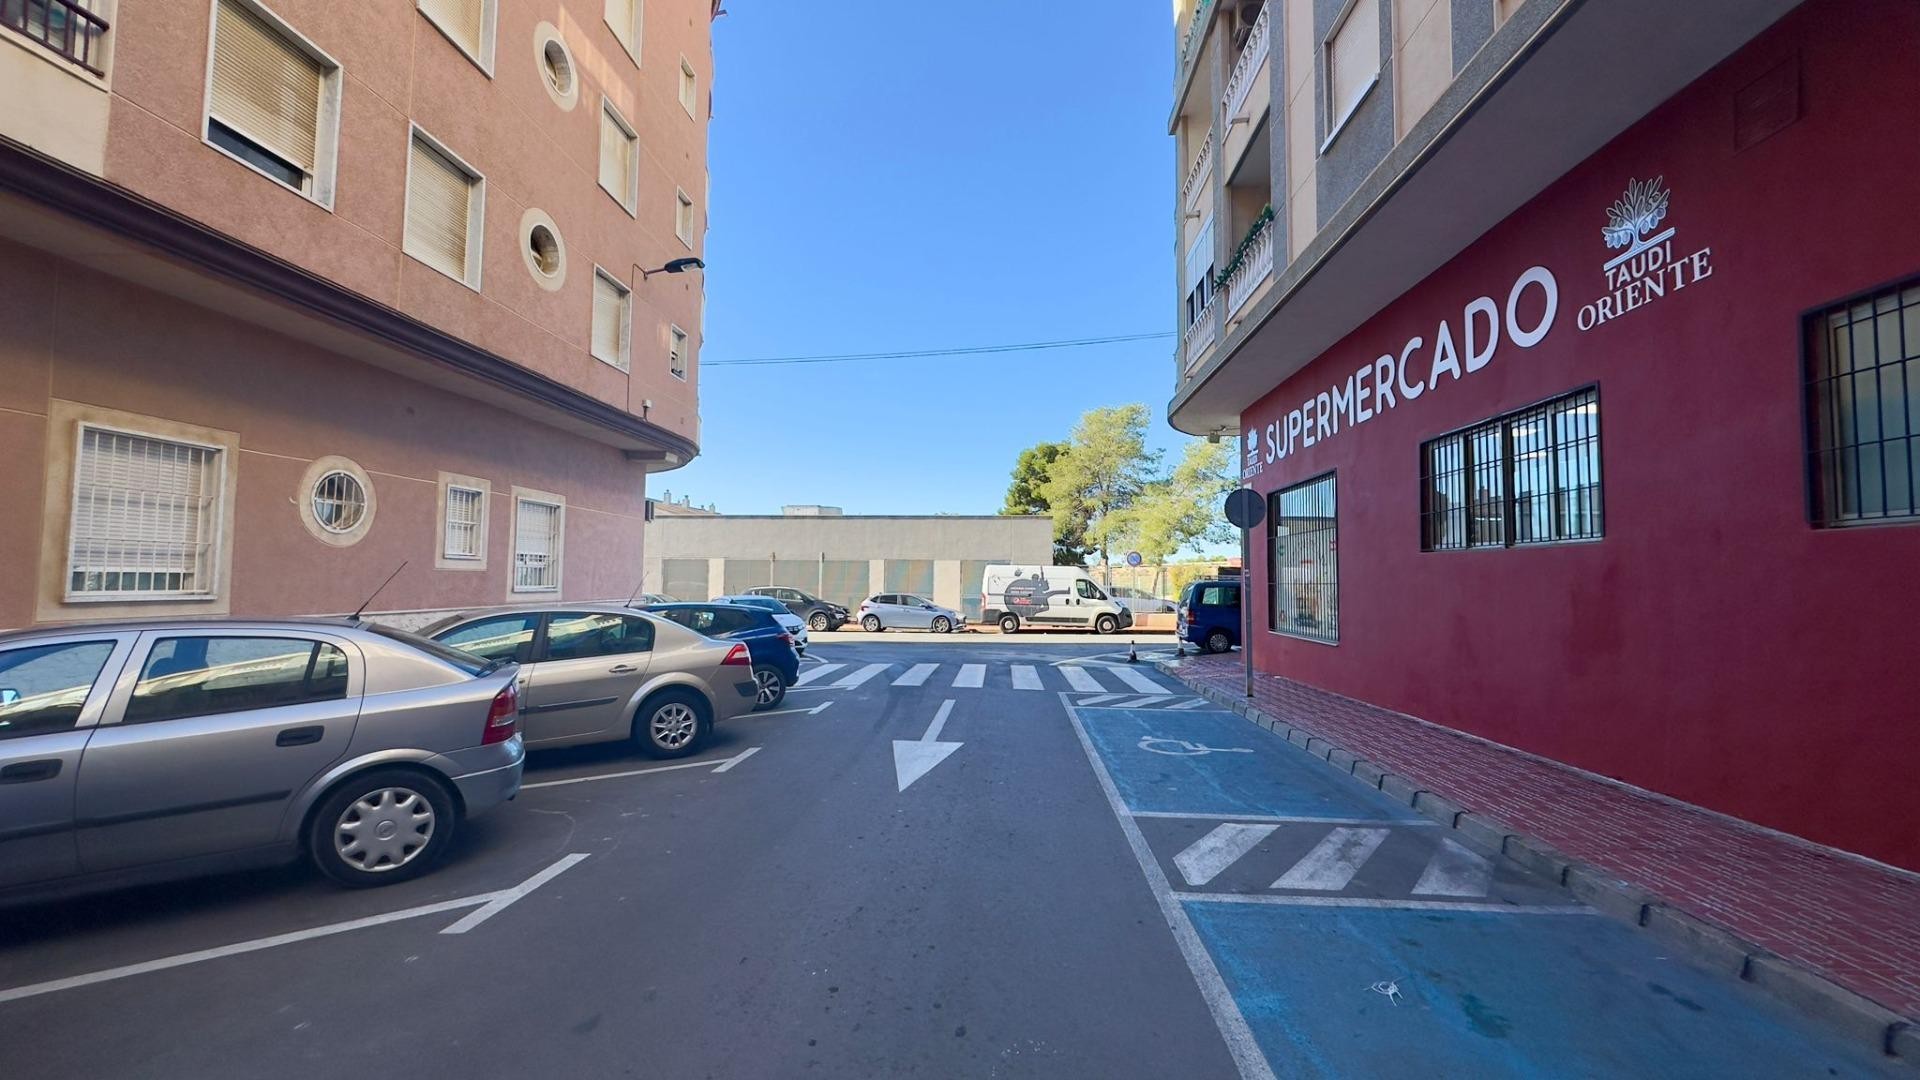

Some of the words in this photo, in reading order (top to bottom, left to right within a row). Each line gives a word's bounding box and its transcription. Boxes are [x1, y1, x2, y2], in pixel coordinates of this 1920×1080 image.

[1577, 247, 1712, 331] ORIENTE
[1604, 241, 1671, 291] TAUDI
[1266, 266, 1558, 464] SUPERMERCADO
